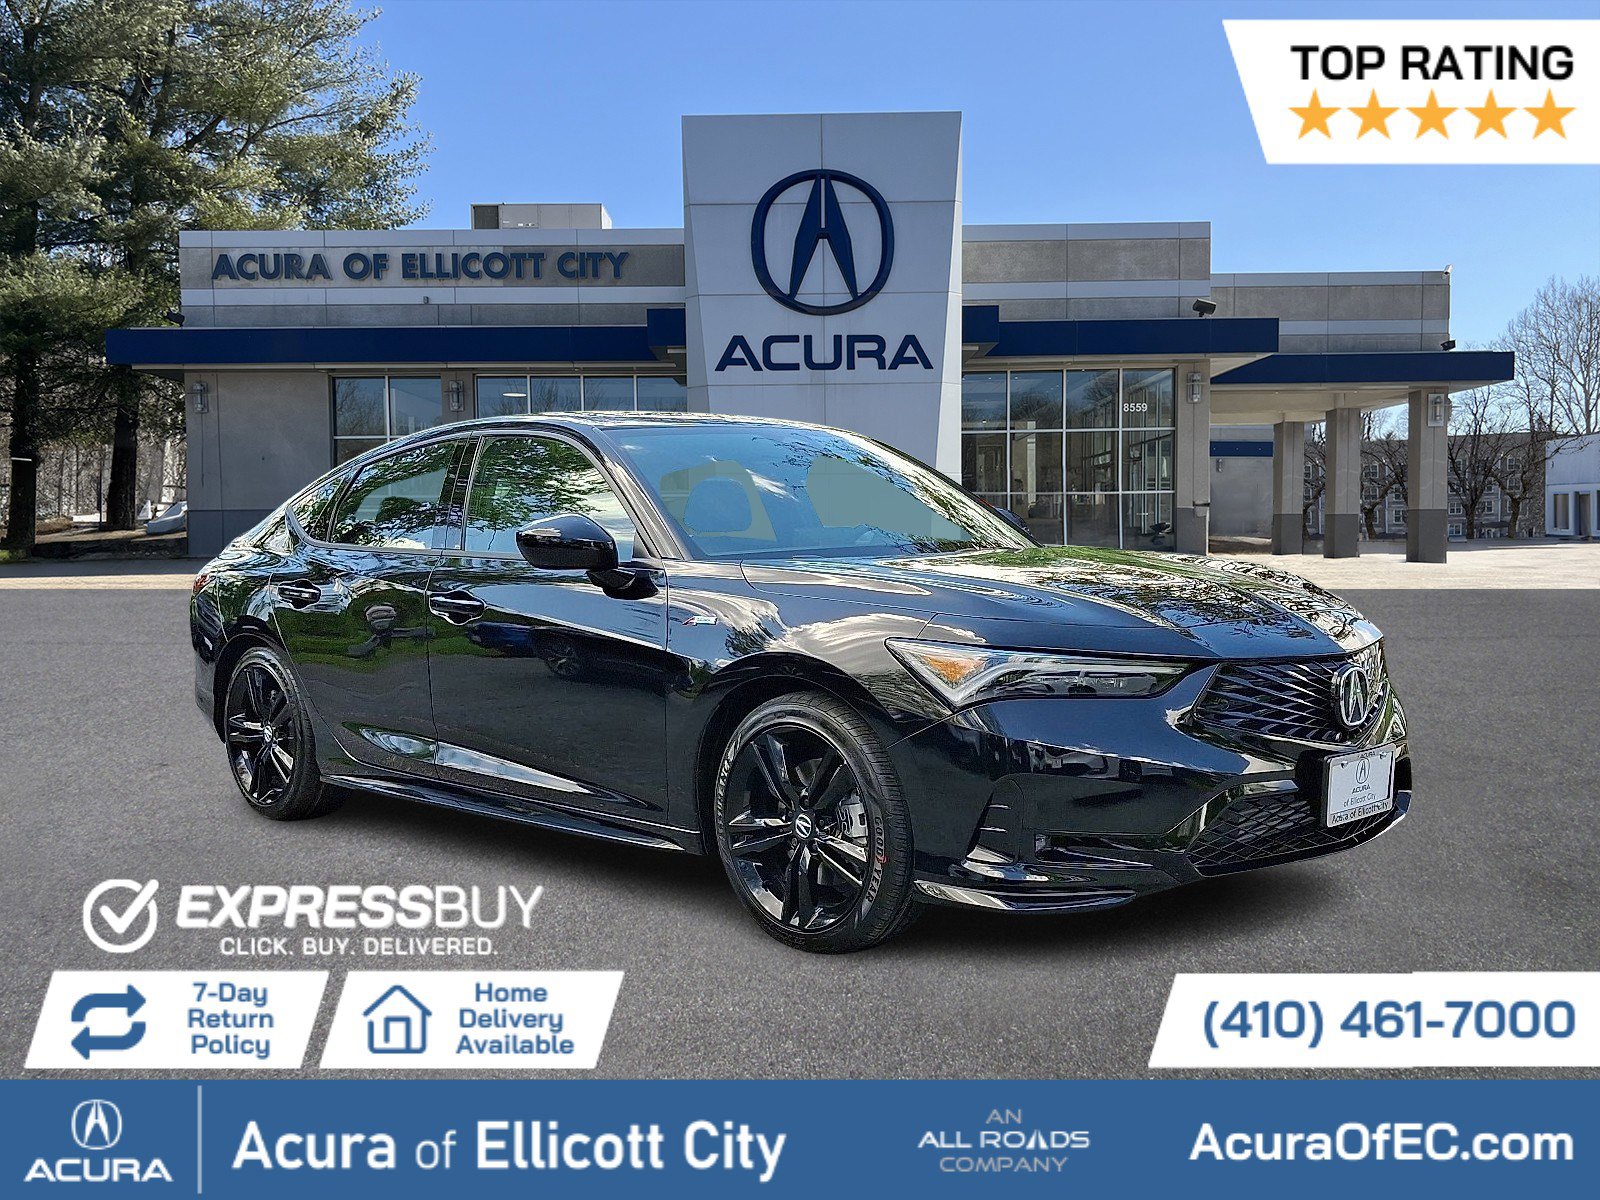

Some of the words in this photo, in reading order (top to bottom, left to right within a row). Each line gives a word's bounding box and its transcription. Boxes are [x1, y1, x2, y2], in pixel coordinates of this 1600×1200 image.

[211, 253, 333, 281] ACURA
[342, 252, 389, 280] OF
[401, 251, 546, 280] ELLICOTT
[556, 251, 629, 280] CITY
[714, 334, 934, 372] ACURA
[1122, 402, 1149, 413] 8559
[1352, 784, 1371, 794] ACURA
